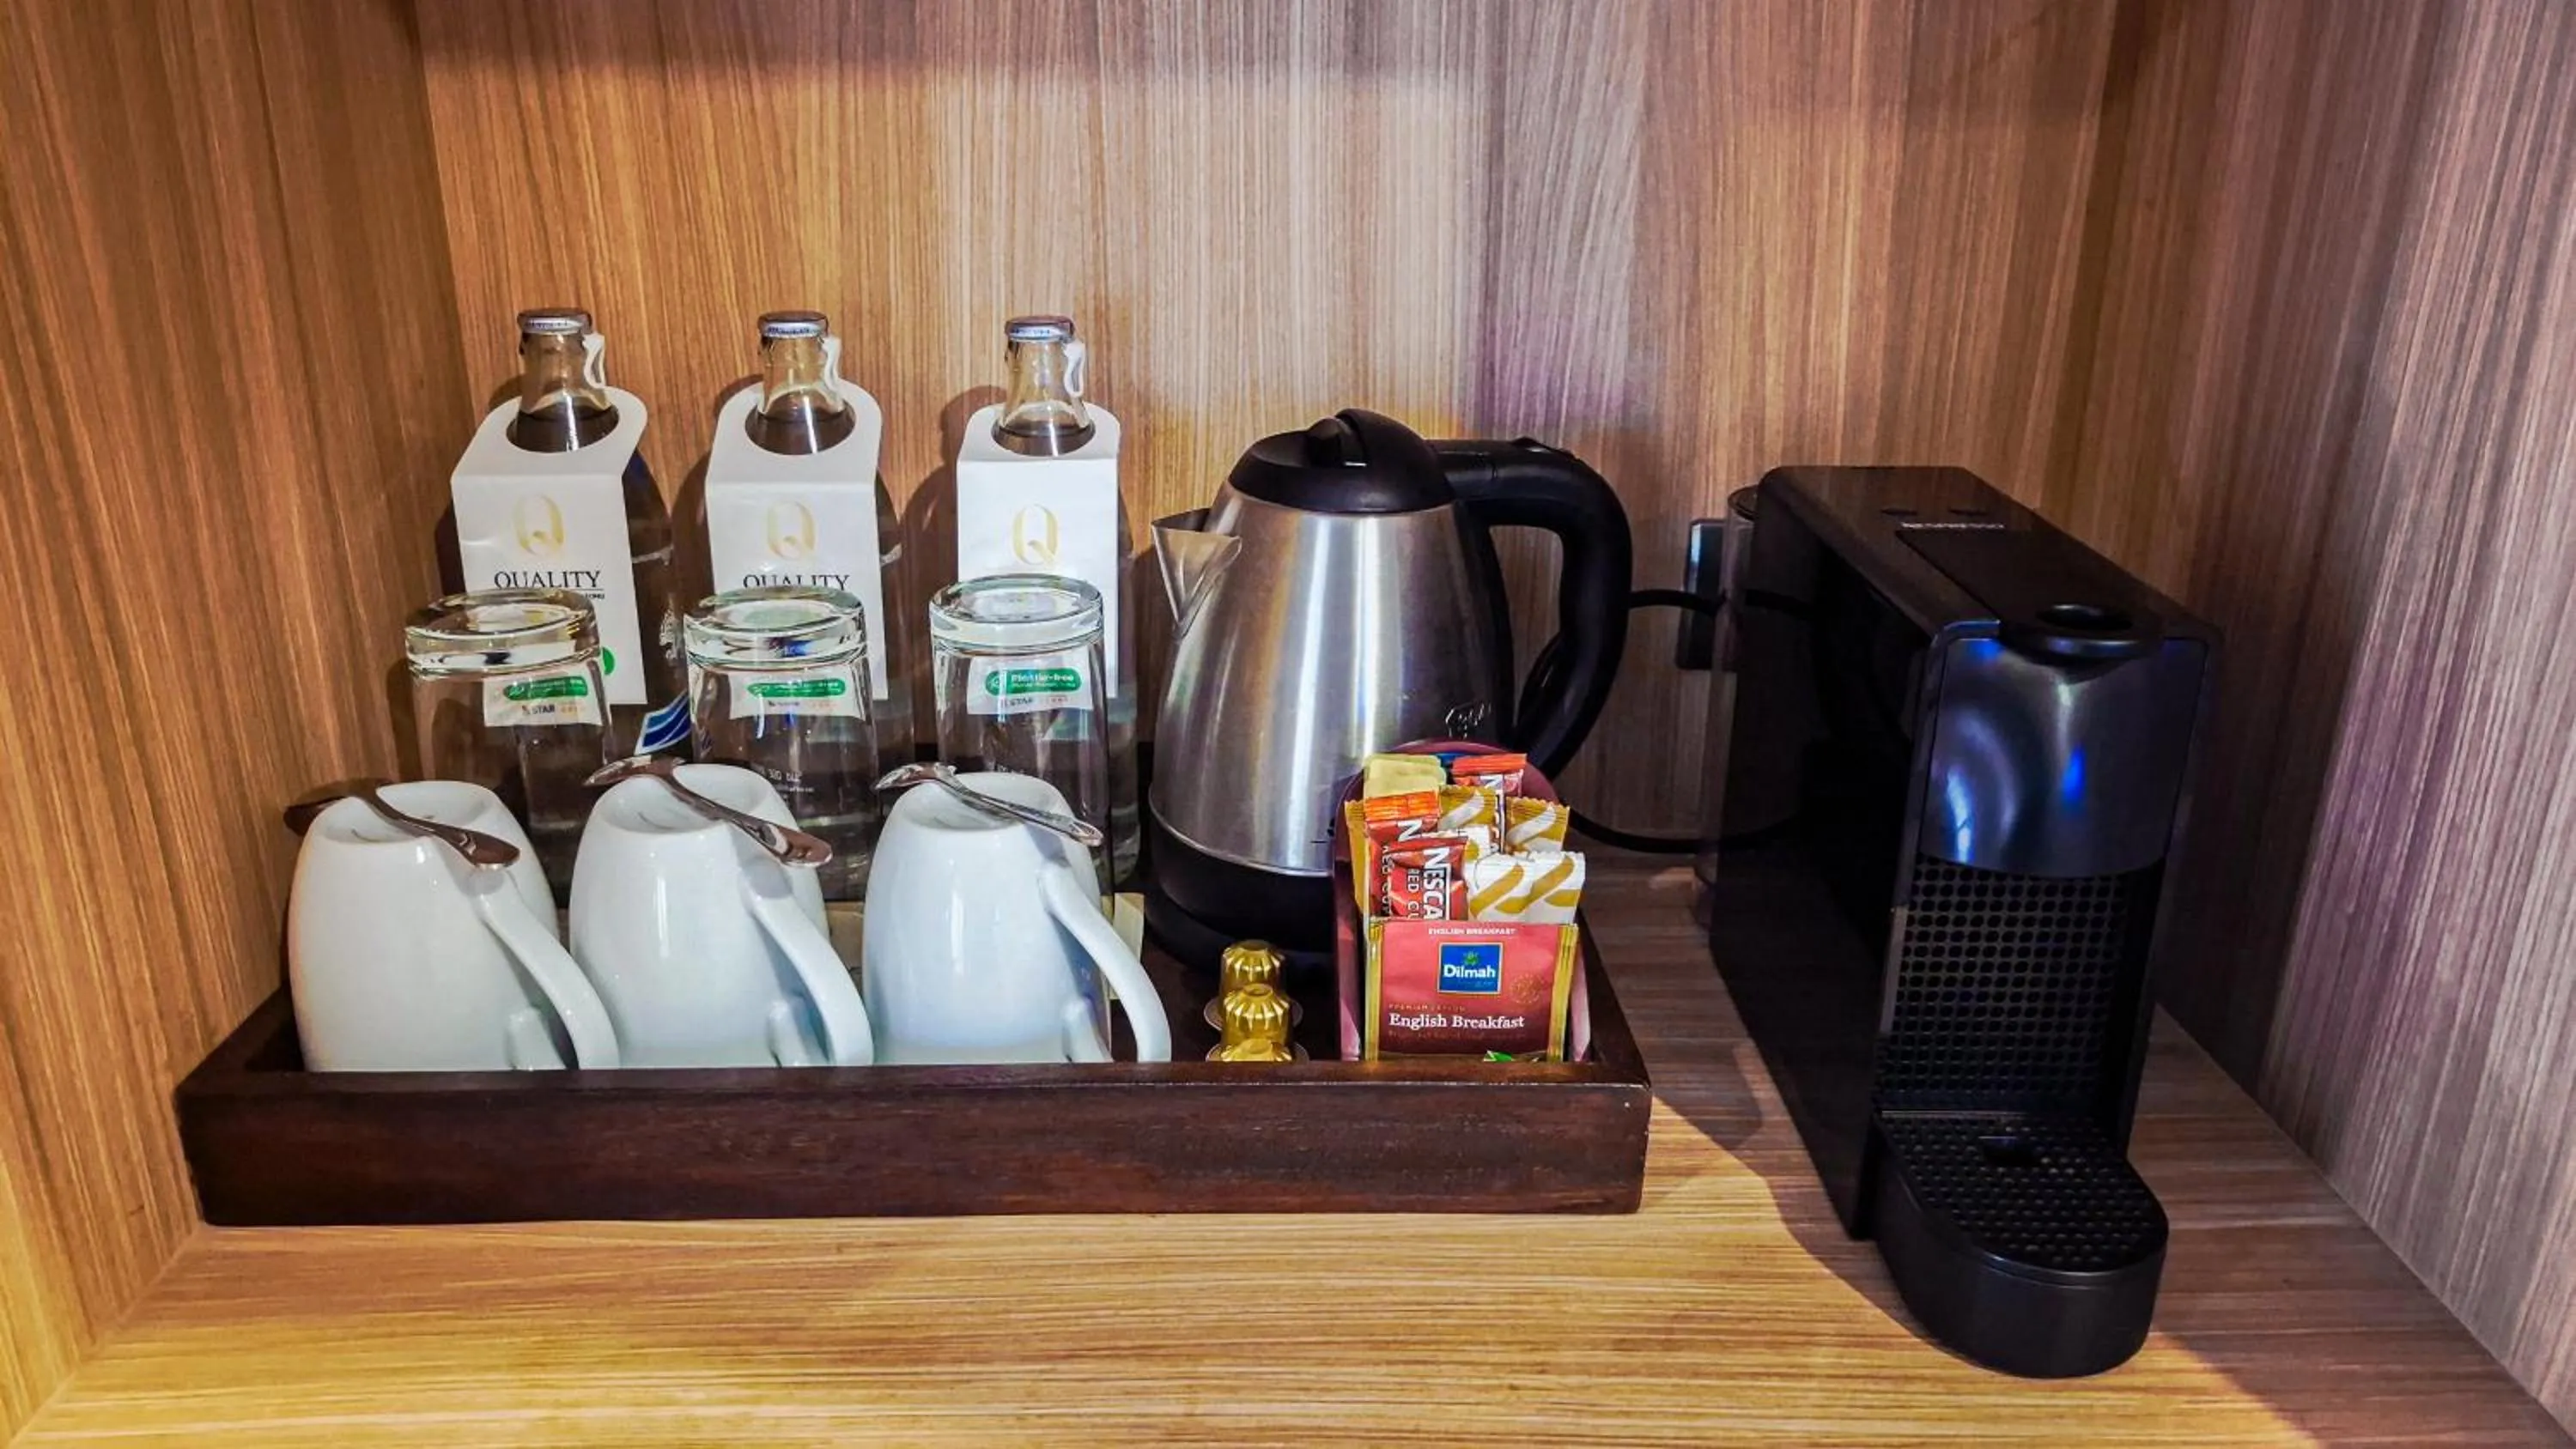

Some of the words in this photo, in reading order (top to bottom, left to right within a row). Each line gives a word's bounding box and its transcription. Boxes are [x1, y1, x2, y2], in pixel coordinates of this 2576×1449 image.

[494, 570, 601, 590] QUALITY
[1443, 964, 1496, 979] Dilmah
[1389, 1013, 1447, 1031] English
[1452, 1016, 1525, 1029] Breakfast
